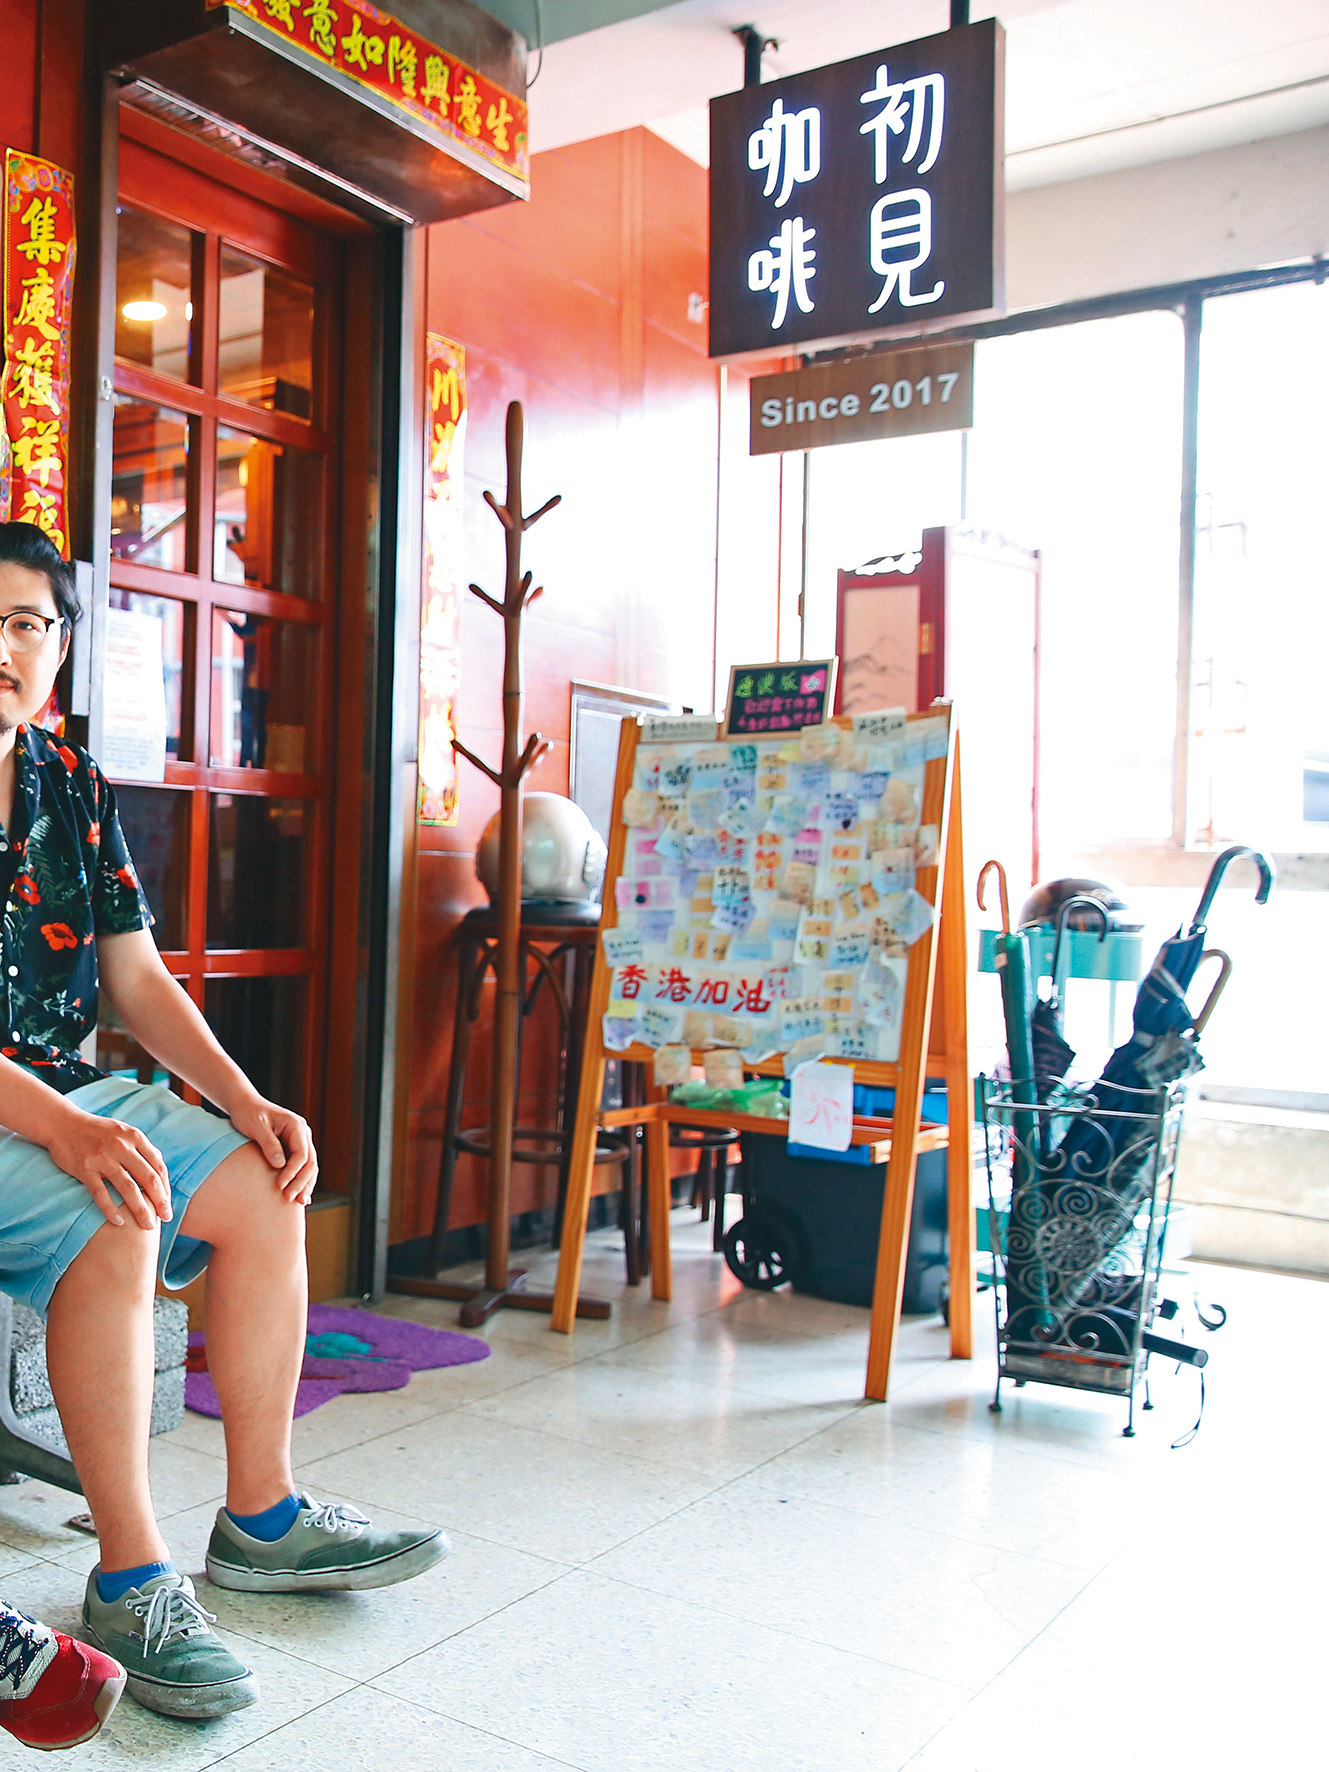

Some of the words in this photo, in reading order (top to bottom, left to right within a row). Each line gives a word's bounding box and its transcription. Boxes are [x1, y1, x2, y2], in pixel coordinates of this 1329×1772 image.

[747, 97, 821, 330] 咖啡
[859, 63, 945, 313] 初見
[760, 388, 860, 428] Since
[869, 371, 960, 414] 2017
[616, 963, 771, 1013] 香港加油
